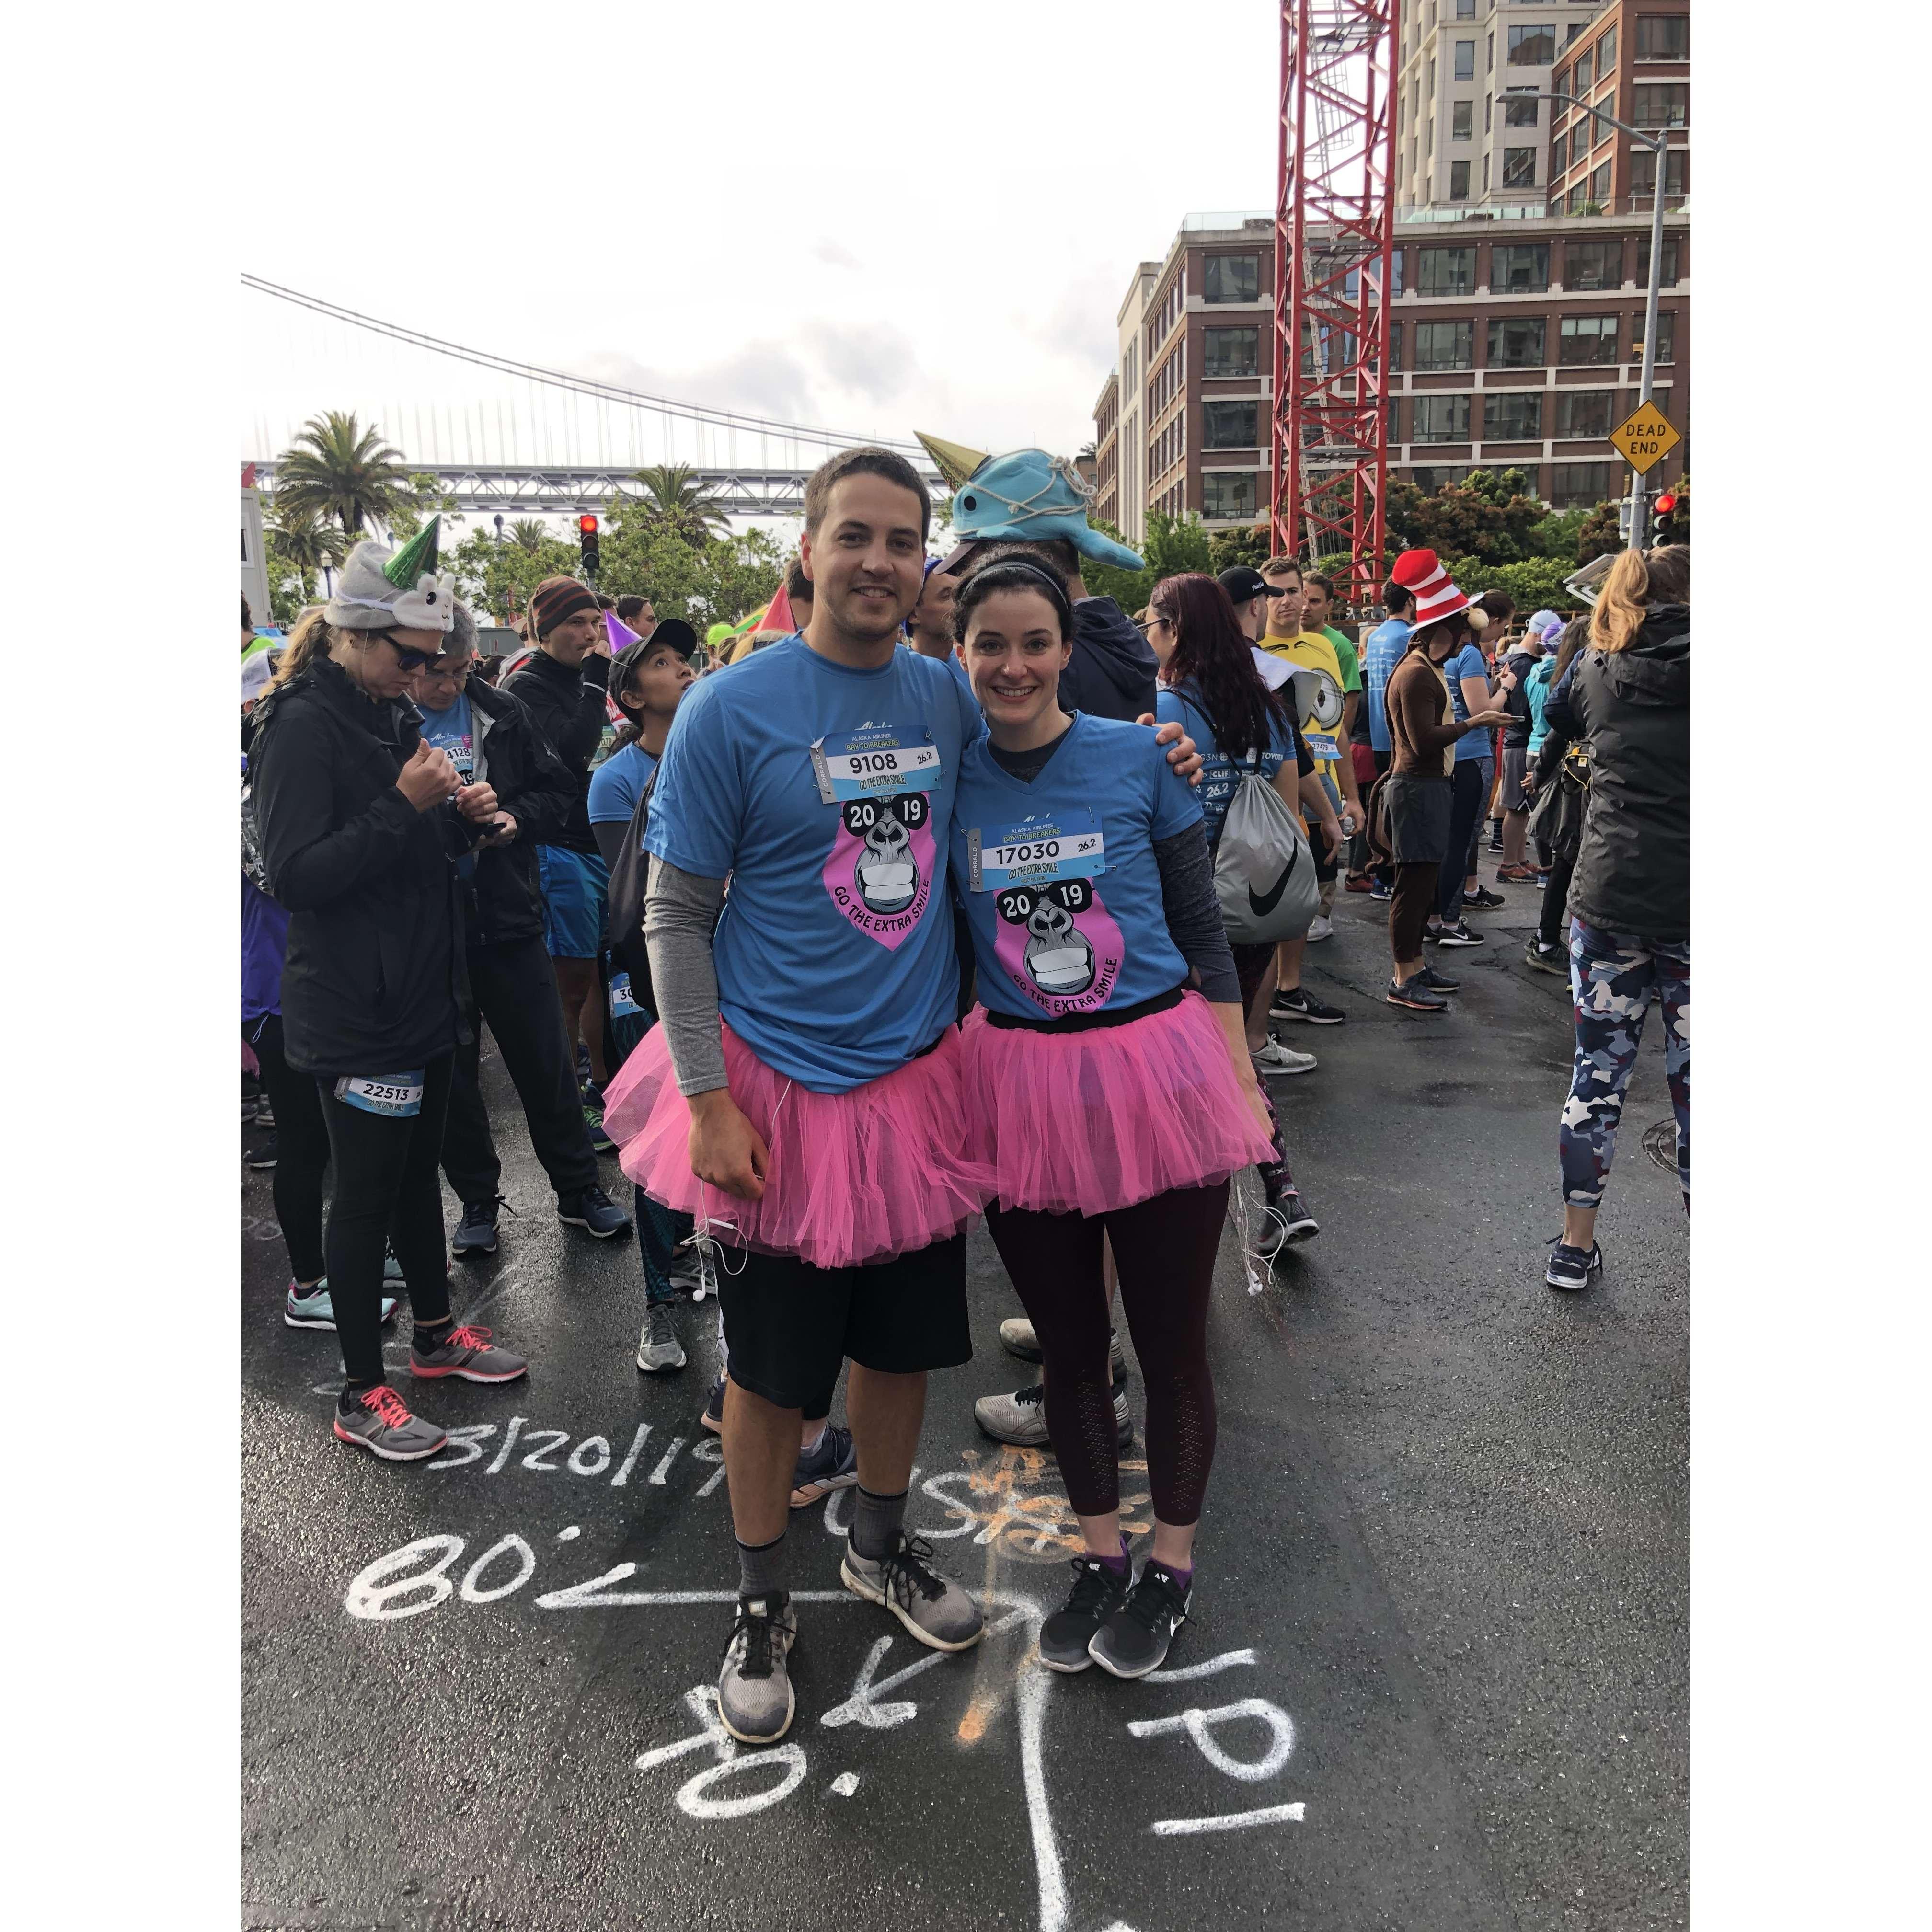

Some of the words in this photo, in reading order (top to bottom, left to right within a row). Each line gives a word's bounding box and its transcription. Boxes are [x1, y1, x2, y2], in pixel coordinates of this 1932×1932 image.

[1626, 424, 1666, 437] DEAD
[1630, 442, 1658, 454] END
[846, 743, 860, 751] BAY
[870, 739, 899, 748] BREAKERS
[850, 753, 897, 774] 9108
[917, 751, 933, 765] 26.2
[818, 760, 828, 787] CORRAL
[860, 780, 867, 790] GO
[867, 776, 876, 788] THE
[876, 774, 891, 786] EXTRA
[890, 774, 907, 785] SMILE
[1206, 782, 1229, 798] 26.2
[850, 805, 875, 828] 20
[903, 799, 921, 821] 19
[1028, 828, 1061, 839] BREAKERS
[996, 841, 1060, 865] 17030
[1078, 839, 1096, 852] 26.2
[1009, 868, 1017, 880] GO
[1017, 865, 1027, 877] THE
[1027, 863, 1042, 875] EXTRA
[1042, 862, 1059, 873] SMILE
[834, 886, 850, 906] GO
[849, 904, 873, 928] THE
[874, 914, 912, 932] EXTRA
[912, 879, 929, 919] SMILE
[1003, 895, 1030, 917] 20
[1060, 885, 1083, 907] 19
[1013, 975, 1027, 990] GO
[1030, 989, 1051, 1010] THE
[1054, 995, 1097, 1012] EXTRA
[1094, 958, 1117, 998] SMILE
[363, 1083, 409, 1101] 22513
